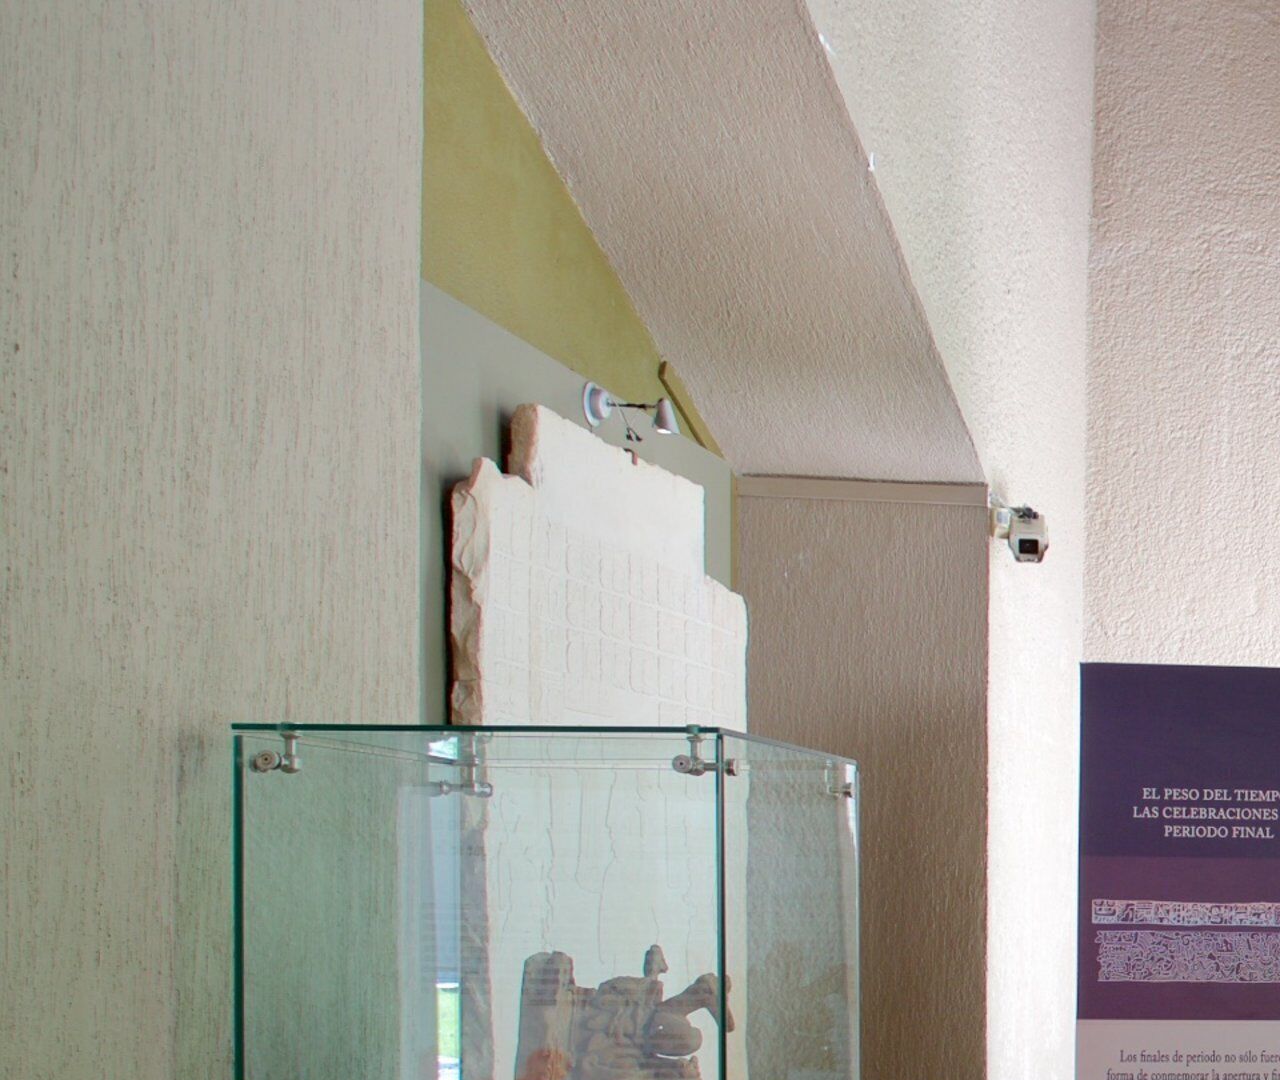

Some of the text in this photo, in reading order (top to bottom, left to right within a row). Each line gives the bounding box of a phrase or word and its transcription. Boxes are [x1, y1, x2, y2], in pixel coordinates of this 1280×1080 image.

[1142, 788, 1160, 800] EL
[1164, 788, 1200, 800] PESO
[1202, 788, 1232, 801] DEL
[1132, 806, 1159, 818] LAS
[1162, 806, 1279, 820] CELEBRACIONES
[1164, 825, 1275, 838] PERIODO FINAL
[1120, 1050, 1137, 1063] Los
[1140, 1050, 1170, 1063] finales
[1172, 1050, 1183, 1063] de
[1185, 1050, 1221, 1067] periodo
[1224, 1054, 1236, 1063] no
[1239, 1050, 1257, 1063] sólo
[1106, 1068, 1134, 1080] forma
[1136, 1068, 1148, 1080] de
[1150, 1072, 1209, 1080] conmemorar
[1211, 1068, 1220, 1080] la
